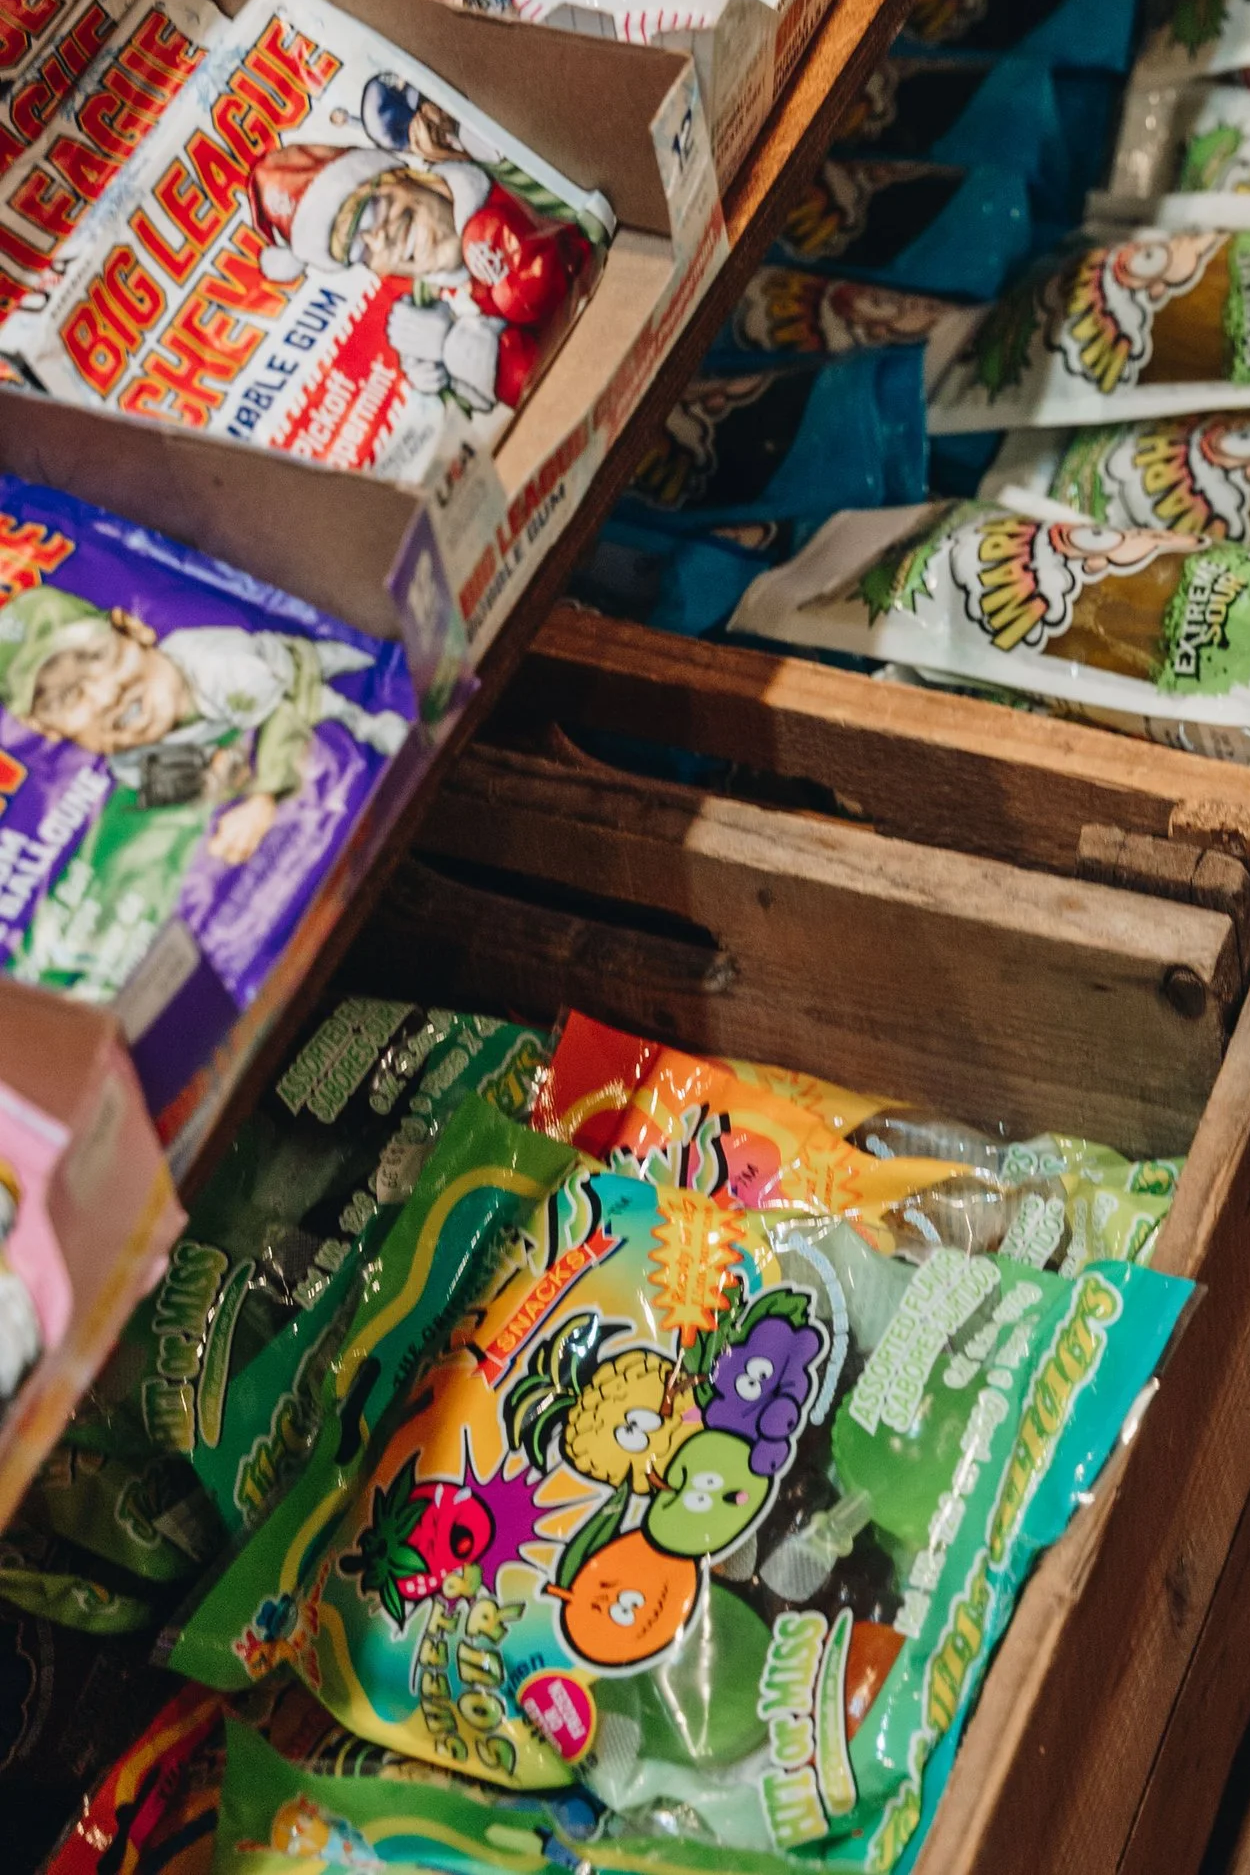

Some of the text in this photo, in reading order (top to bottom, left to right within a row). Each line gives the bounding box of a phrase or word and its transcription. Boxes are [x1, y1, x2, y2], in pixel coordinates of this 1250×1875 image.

[128, 14, 346, 289] LEAGUE
[672, 107, 694, 172] 12
[59, 243, 169, 402] BIG
[116, 218, 308, 429] CHEW
[282, 287, 348, 352] GUM
[526, 482, 567, 544] GUM
[1175, 556, 1228, 678] EXTREME
[1201, 571, 1249, 646] SOUR
[153, 1240, 228, 1335] MISS
[496, 1248, 585, 1353] SNACKS
[882, 1326, 944, 1429] SABORES
[930, 1257, 999, 1331] SURTIDOS
[856, 1314, 918, 1428] ASSORTED
[420, 1600, 468, 1762] SWEET
[456, 1598, 527, 1777] SOUR
[759, 1612, 829, 1851] HIT OR MISS
